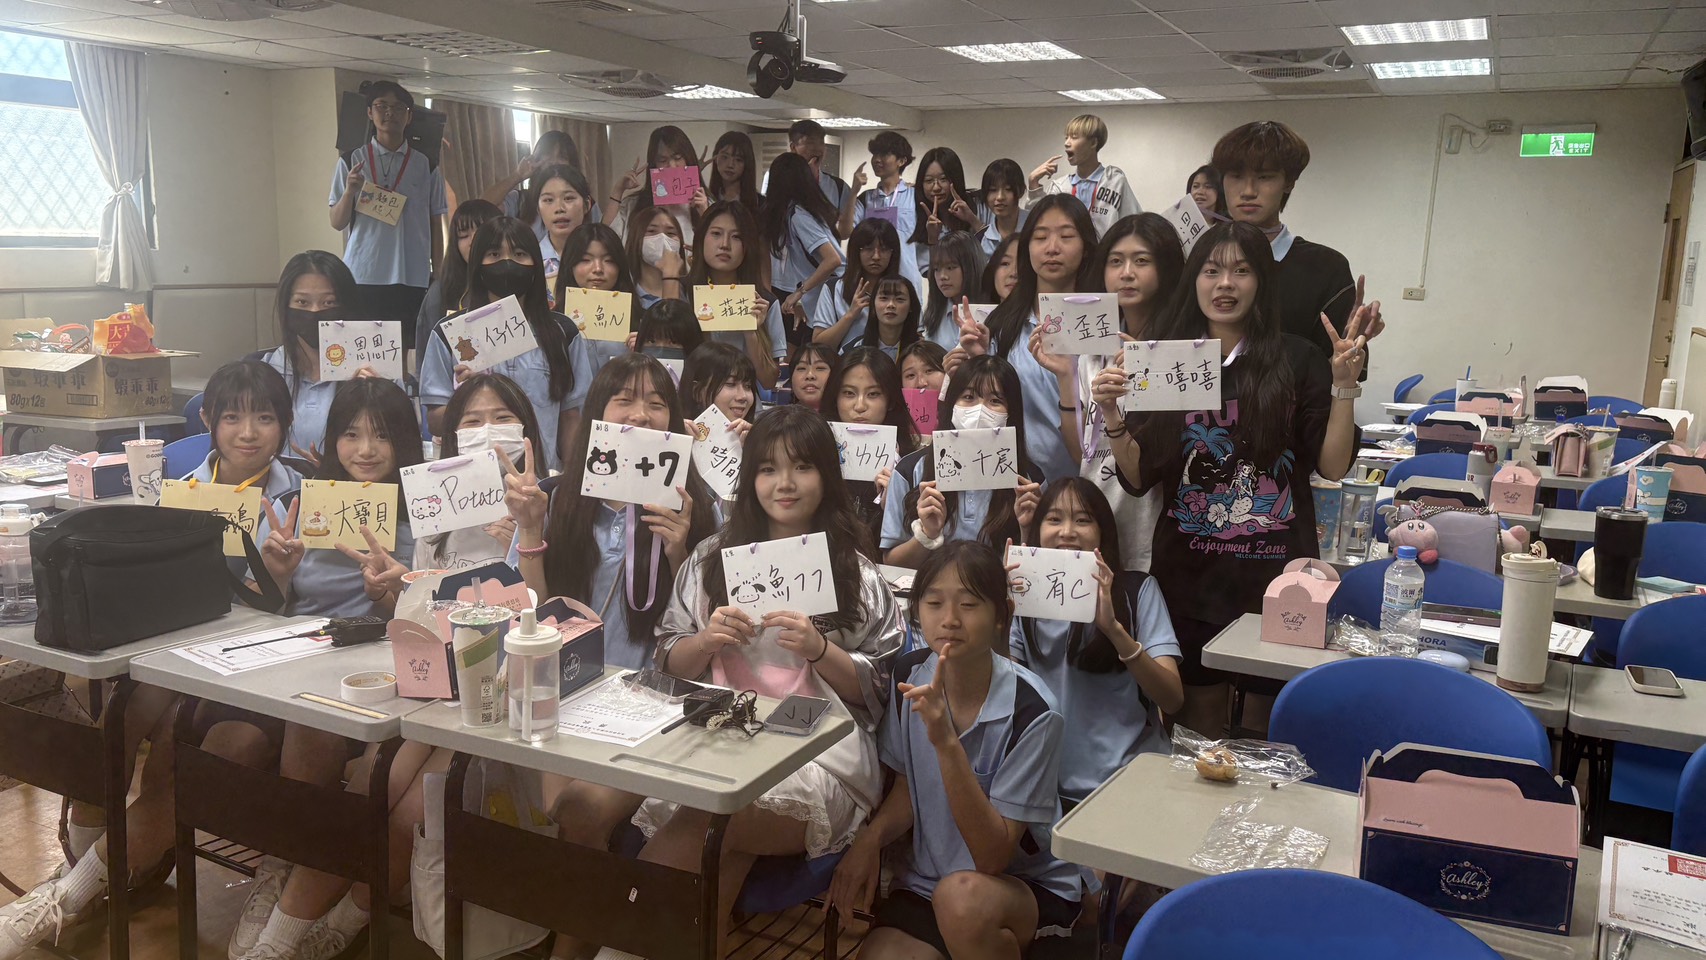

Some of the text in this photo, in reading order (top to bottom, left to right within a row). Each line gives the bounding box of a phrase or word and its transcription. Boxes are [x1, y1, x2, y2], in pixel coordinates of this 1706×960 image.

[1074, 313, 1117, 341] 歪歪
[1165, 359, 1218, 393] 嘻嘻
[634, 450, 681, 488] +7
[439, 475, 505, 516] Potato
[334, 498, 390, 538] 大寶貝
[1189, 536, 1287, 555] Enjoyment Zone
[412, 662, 429, 675] Ashley
[1446, 870, 1485, 891] Ashley
